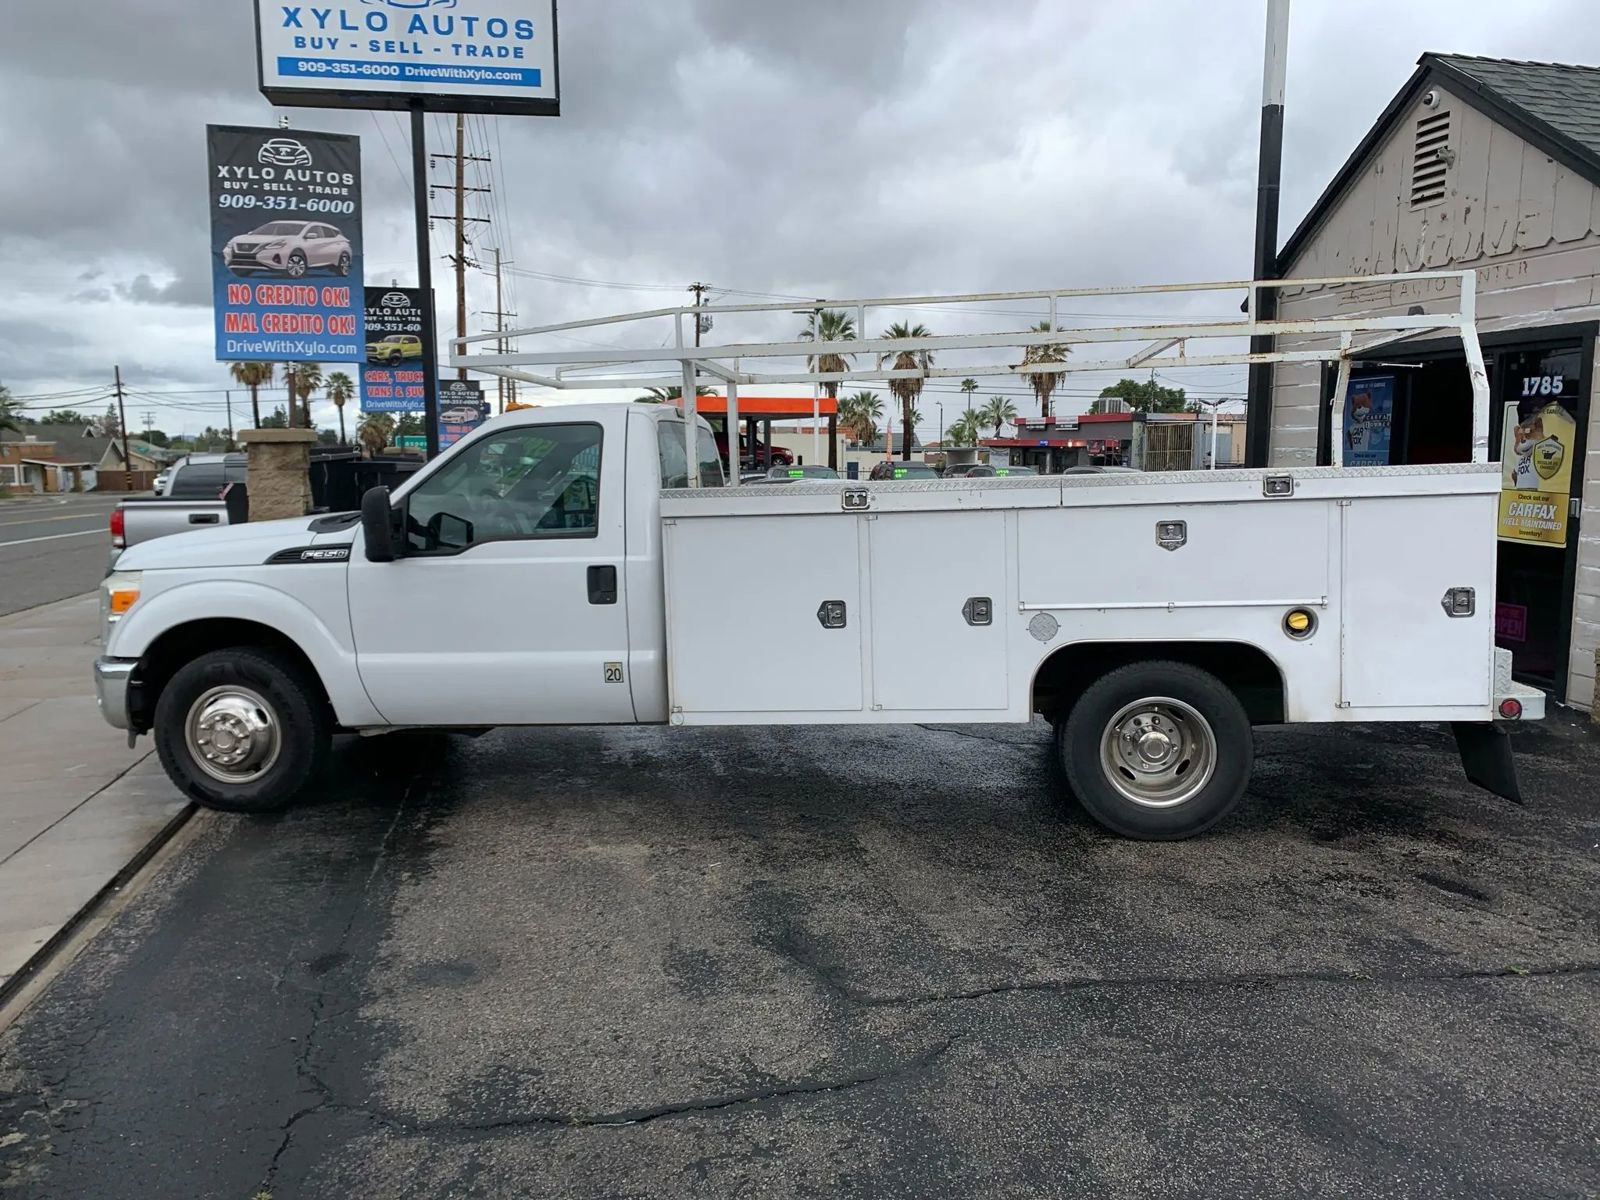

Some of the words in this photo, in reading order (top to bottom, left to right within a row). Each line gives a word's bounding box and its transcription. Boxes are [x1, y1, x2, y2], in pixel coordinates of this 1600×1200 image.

[282, 7, 388, 32] XYLO
[407, 13, 534, 40] AUTOS
[294, 36, 338, 50] BUY
[369, 39, 423, 54] SELL
[452, 43, 524, 59] TRADE
[298, 61, 400, 76] 909-351-6000
[405, 66, 522, 81] DriveWithXylo.com
[217, 165, 275, 180] XYLO
[283, 168, 354, 185] AUTOS
[223, 181, 249, 190] BUY
[263, 182, 294, 191] SELL
[307, 185, 349, 196] TRADE
[218, 194, 355, 214] 909-351-6000
[228, 284, 252, 305] NO
[255, 284, 318, 307] CREDITO
[321, 287, 350, 308] OK!
[225, 312, 259, 334] MAL
[261, 313, 323, 335] CREDITO
[327, 315, 356, 336] OK!
[364, 322, 421, 332] 09-351-60
[227, 340, 357, 356] DriveWithXylo.com
[364, 370, 392, 384] CARS,
[1521, 375, 1564, 396] 1785
[367, 386, 392, 398] VANS
[1508, 502, 1558, 520] CARFAX
[1504, 517, 1520, 526] WELL
[1521, 518, 1562, 531] MAINTAINED
[606, 668, 622, 682] 20
